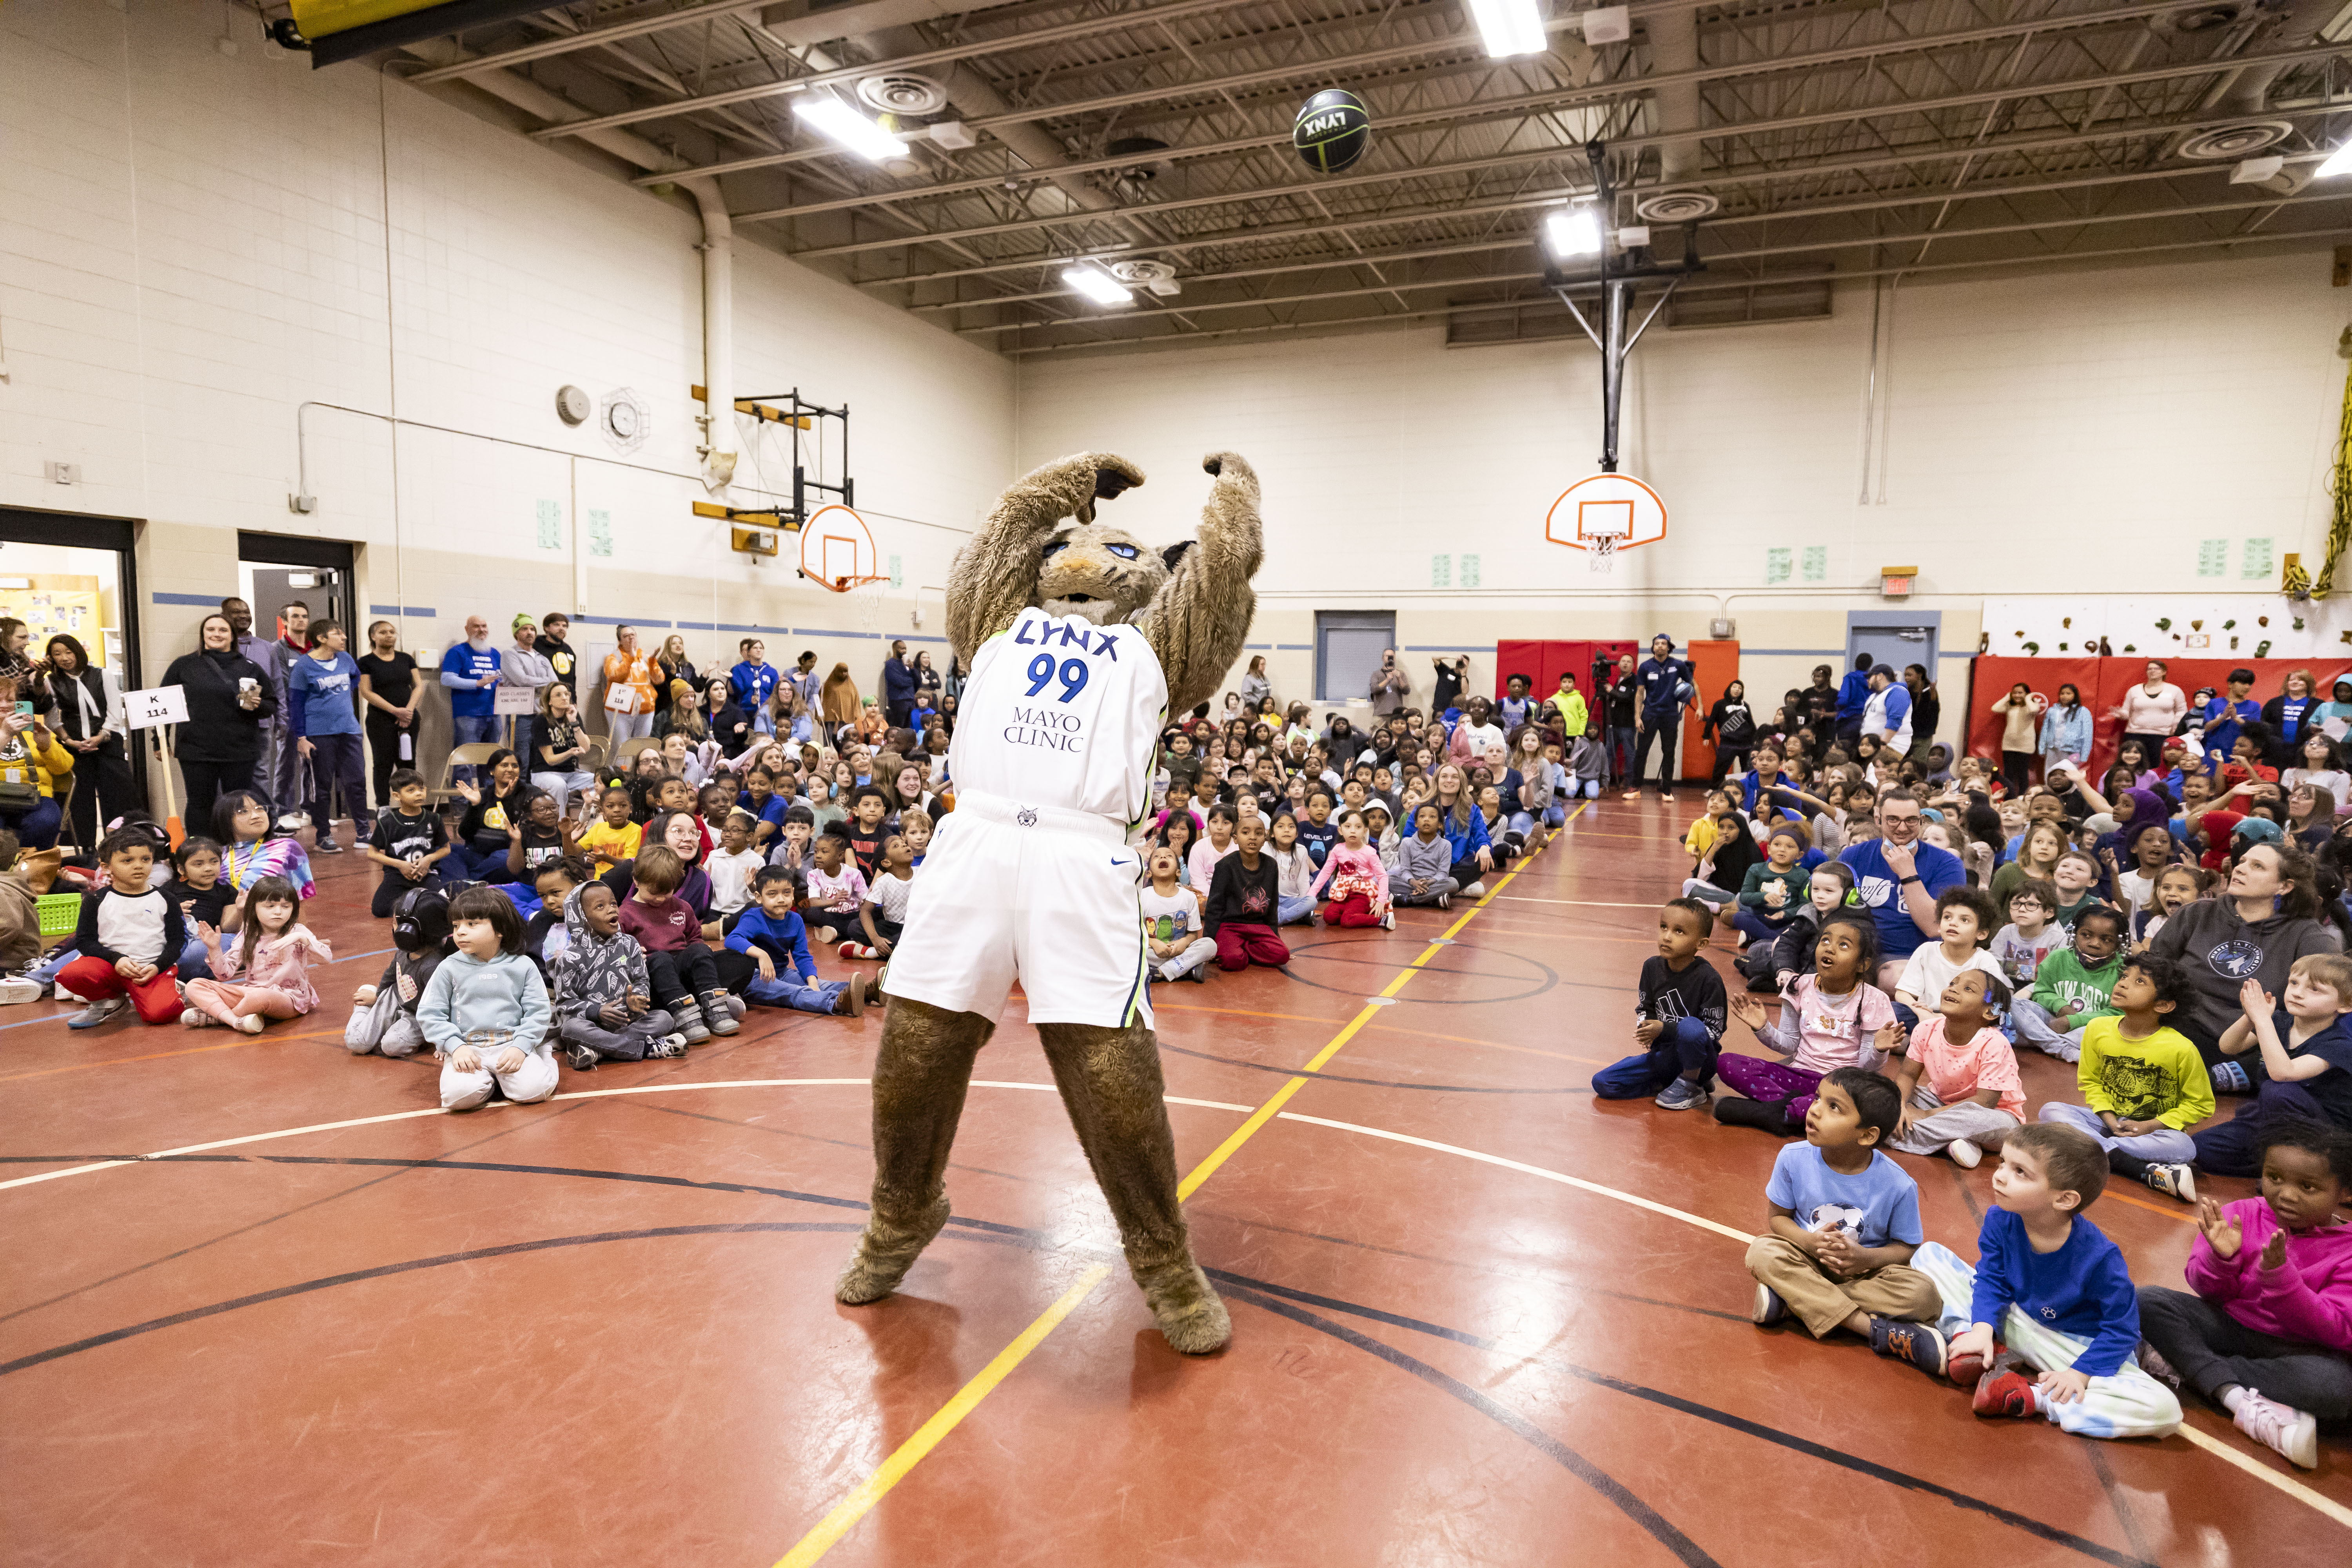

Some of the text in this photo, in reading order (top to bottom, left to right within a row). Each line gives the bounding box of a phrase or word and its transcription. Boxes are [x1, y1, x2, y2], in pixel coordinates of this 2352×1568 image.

[1304, 111, 1346, 137] LYNX
[1887, 579, 1908, 593] EXIT
[1014, 619, 1120, 662] LYNX
[1024, 653, 1089, 703] 99
[150, 695, 159, 703] K
[147, 708, 168, 717] 114
[1012, 707, 1081, 732] MAYO
[1004, 727, 1083, 752] CLINIC
[851, 839, 879, 853] PUMA
[2210, 942, 2241, 959] MINNESTA
[1173, 957, 1184, 970] SONIC
[588, 970, 599, 985] NIKE
